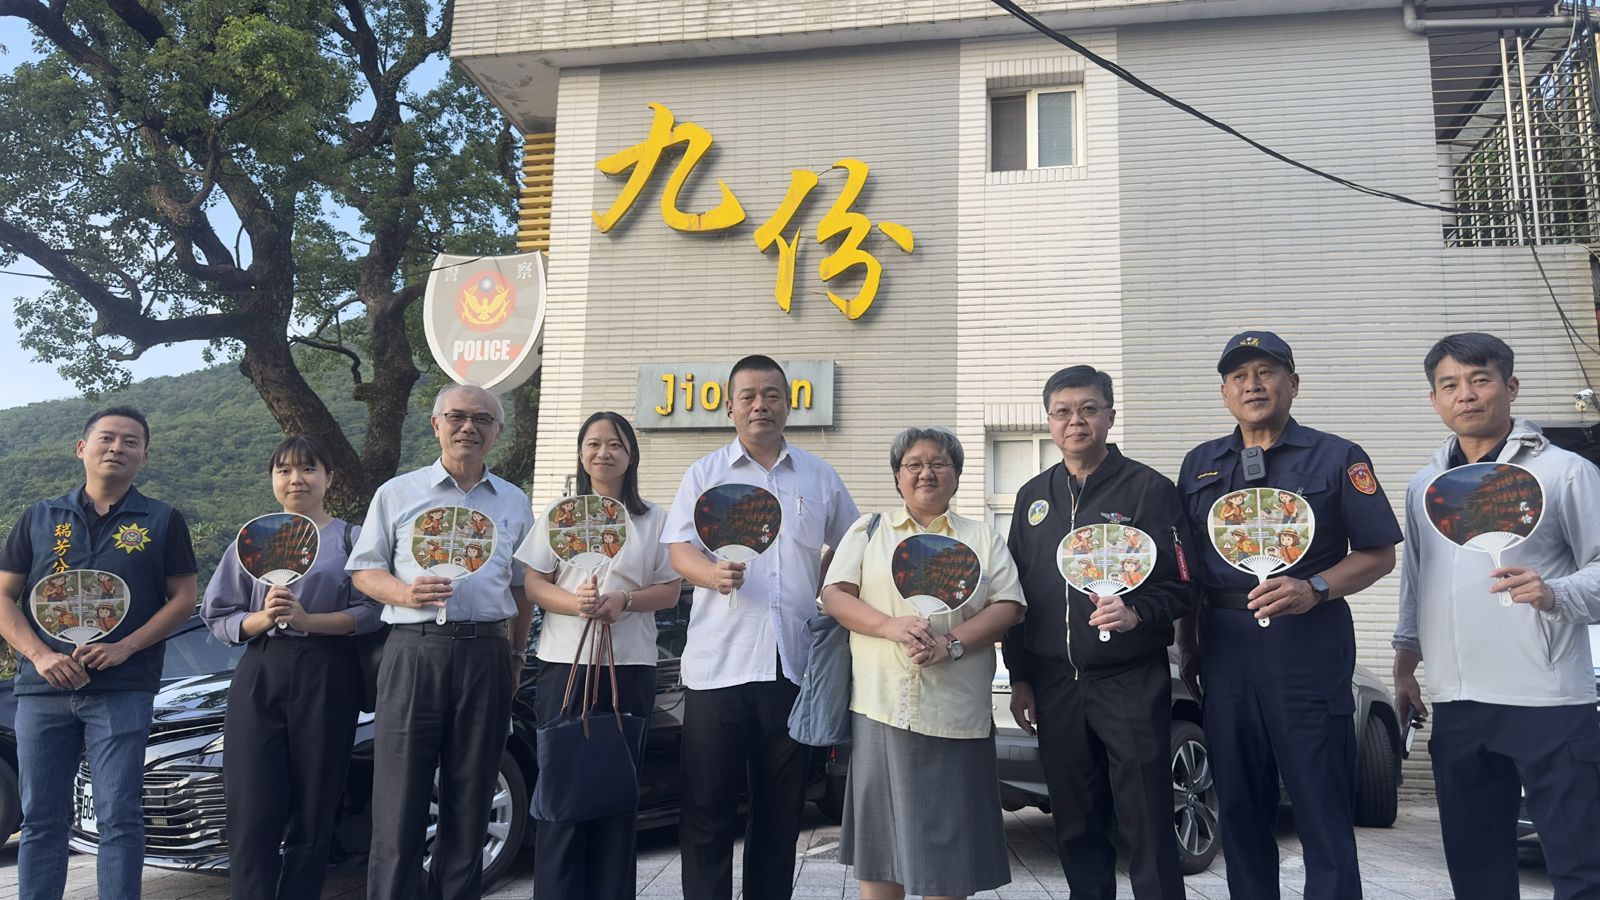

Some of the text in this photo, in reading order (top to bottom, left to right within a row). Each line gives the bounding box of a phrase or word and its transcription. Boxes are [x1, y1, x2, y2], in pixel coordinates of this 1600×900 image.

[591, 101, 914, 320] 九份
[516, 262, 532, 279] 察
[452, 339, 512, 361] POLICE
[655, 373, 812, 417] Jion
